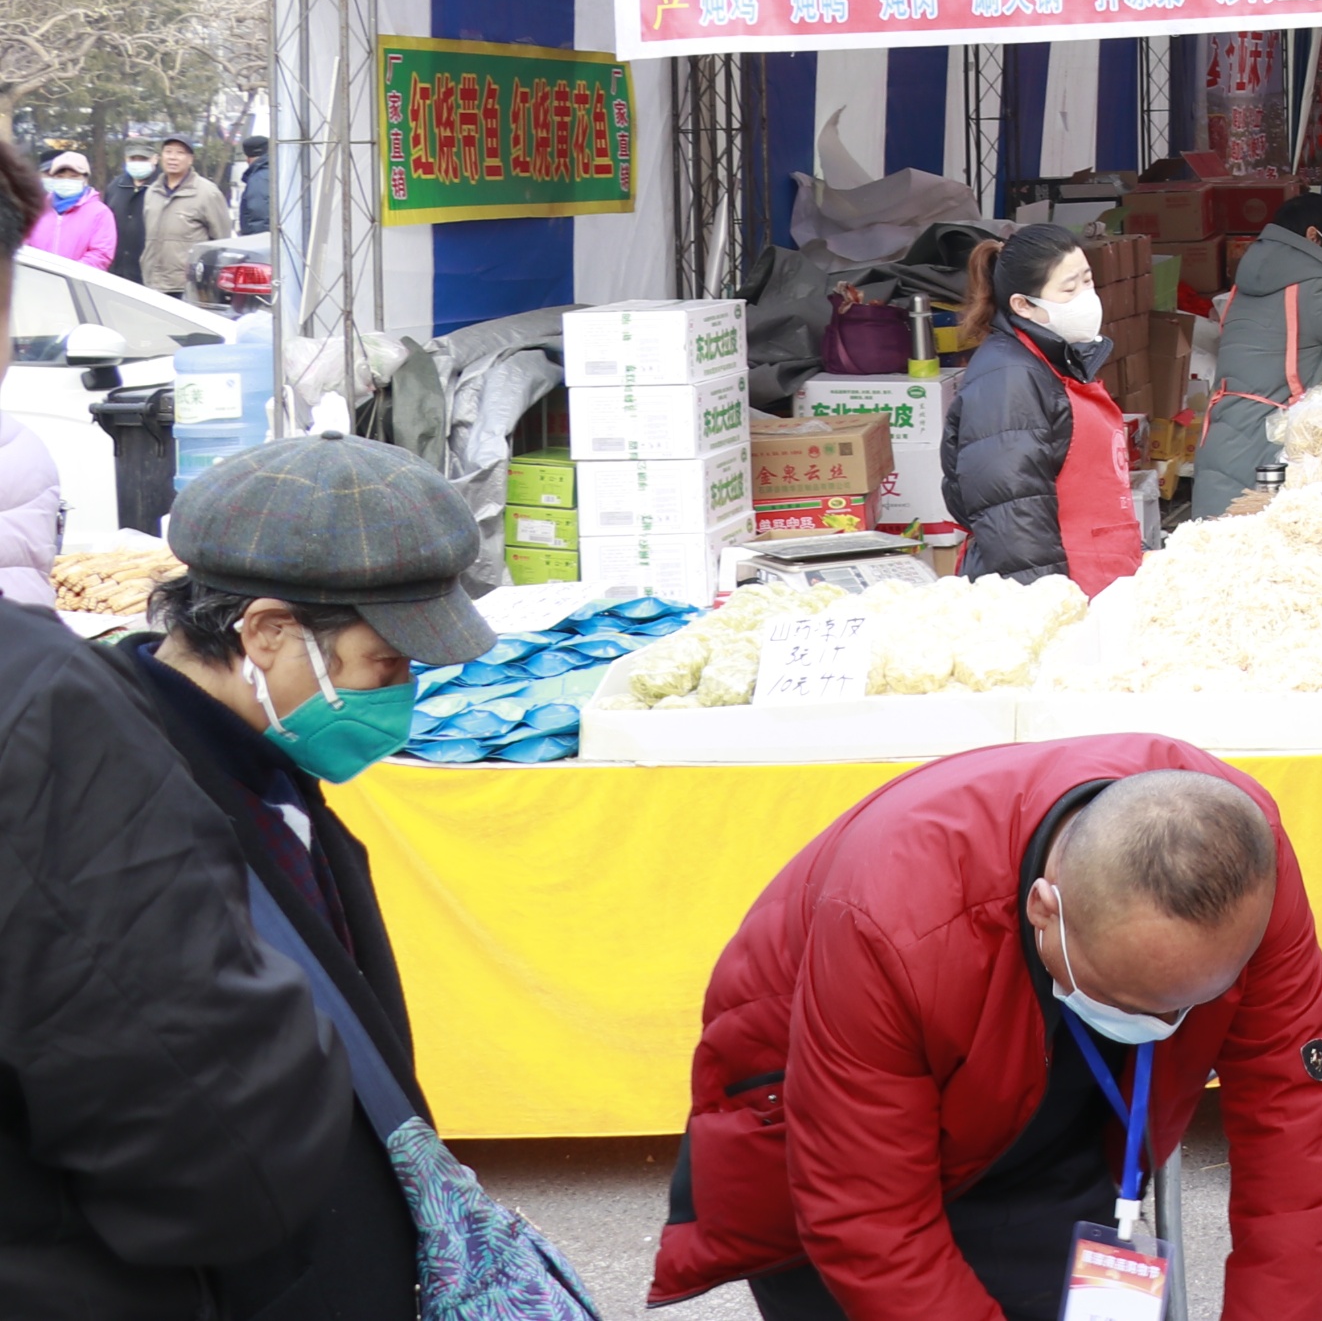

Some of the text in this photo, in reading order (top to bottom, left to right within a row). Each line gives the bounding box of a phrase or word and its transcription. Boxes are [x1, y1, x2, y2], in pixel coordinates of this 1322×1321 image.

[386, 54, 407, 200] 厂家直销
[409, 71, 614, 185] 红烧带鱼 红烧黄花鱼
[611, 68, 631, 192] 厂家直销
[755, 463, 848, 485] 金泉云丝
